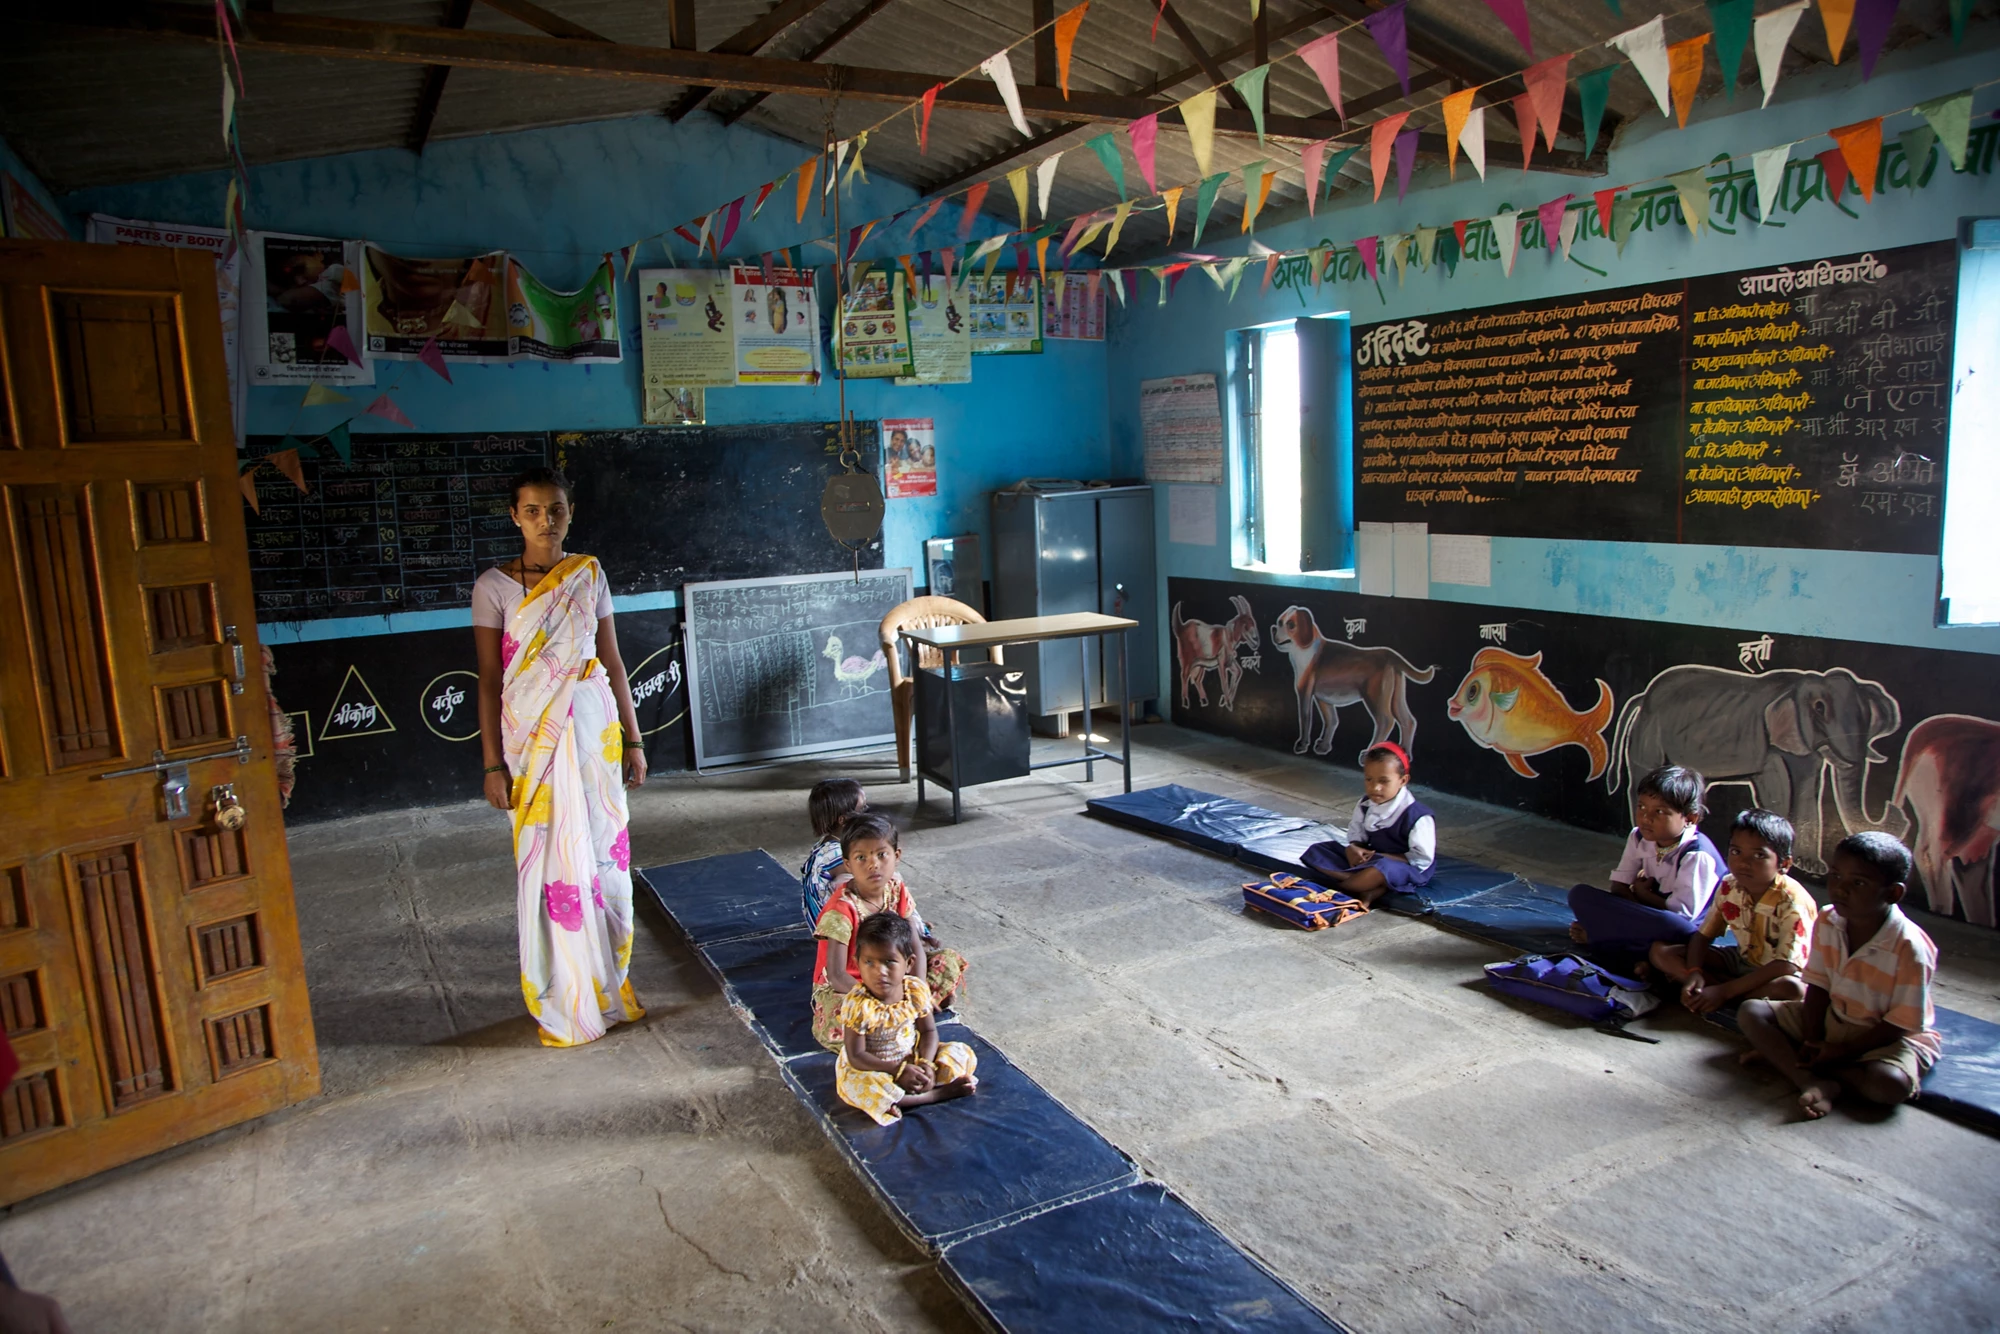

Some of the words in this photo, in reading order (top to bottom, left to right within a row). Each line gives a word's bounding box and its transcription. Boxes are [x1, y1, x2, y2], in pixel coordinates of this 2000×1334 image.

[116, 226, 161, 241] PARTS
[165, 233, 183, 243] OF
[187, 235, 225, 248] BODY
[1738, 267, 1796, 297] आपले
[1640, 291, 1684, 311] विषयक
[1474, 334, 1509, 350] विषयक
[1529, 369, 1559, 385] प्रमाण
[1559, 365, 1587, 382] कमी
[1609, 379, 1633, 398] सर्व
